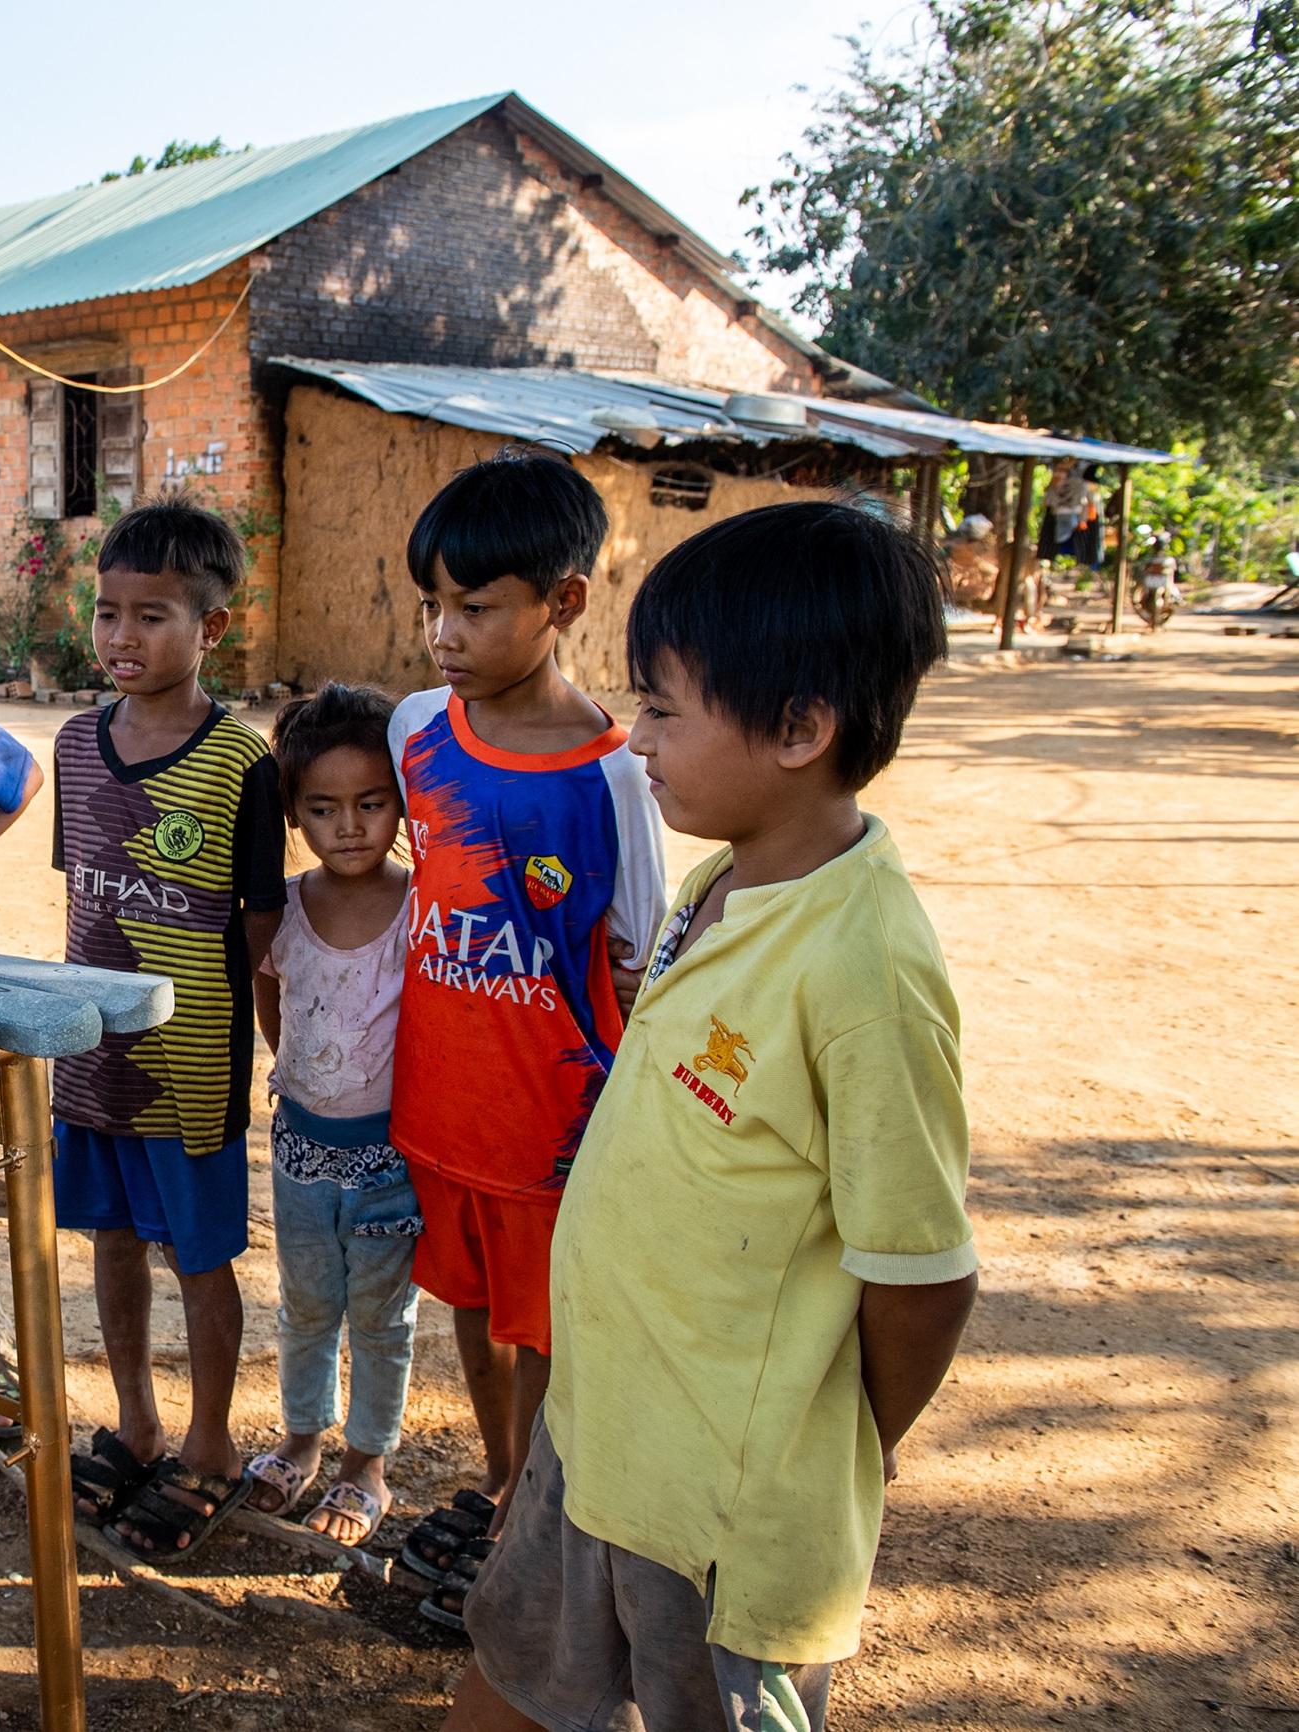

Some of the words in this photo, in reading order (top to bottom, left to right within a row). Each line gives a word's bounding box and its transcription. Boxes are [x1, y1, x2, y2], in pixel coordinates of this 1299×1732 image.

[161, 812, 200, 833] MANCHESTER
[167, 849, 183, 858] CITY
[74, 863, 190, 914] ETIHAD
[418, 952, 557, 1013] AIRWAYS
[672, 1062, 737, 1126] BURBERRY
